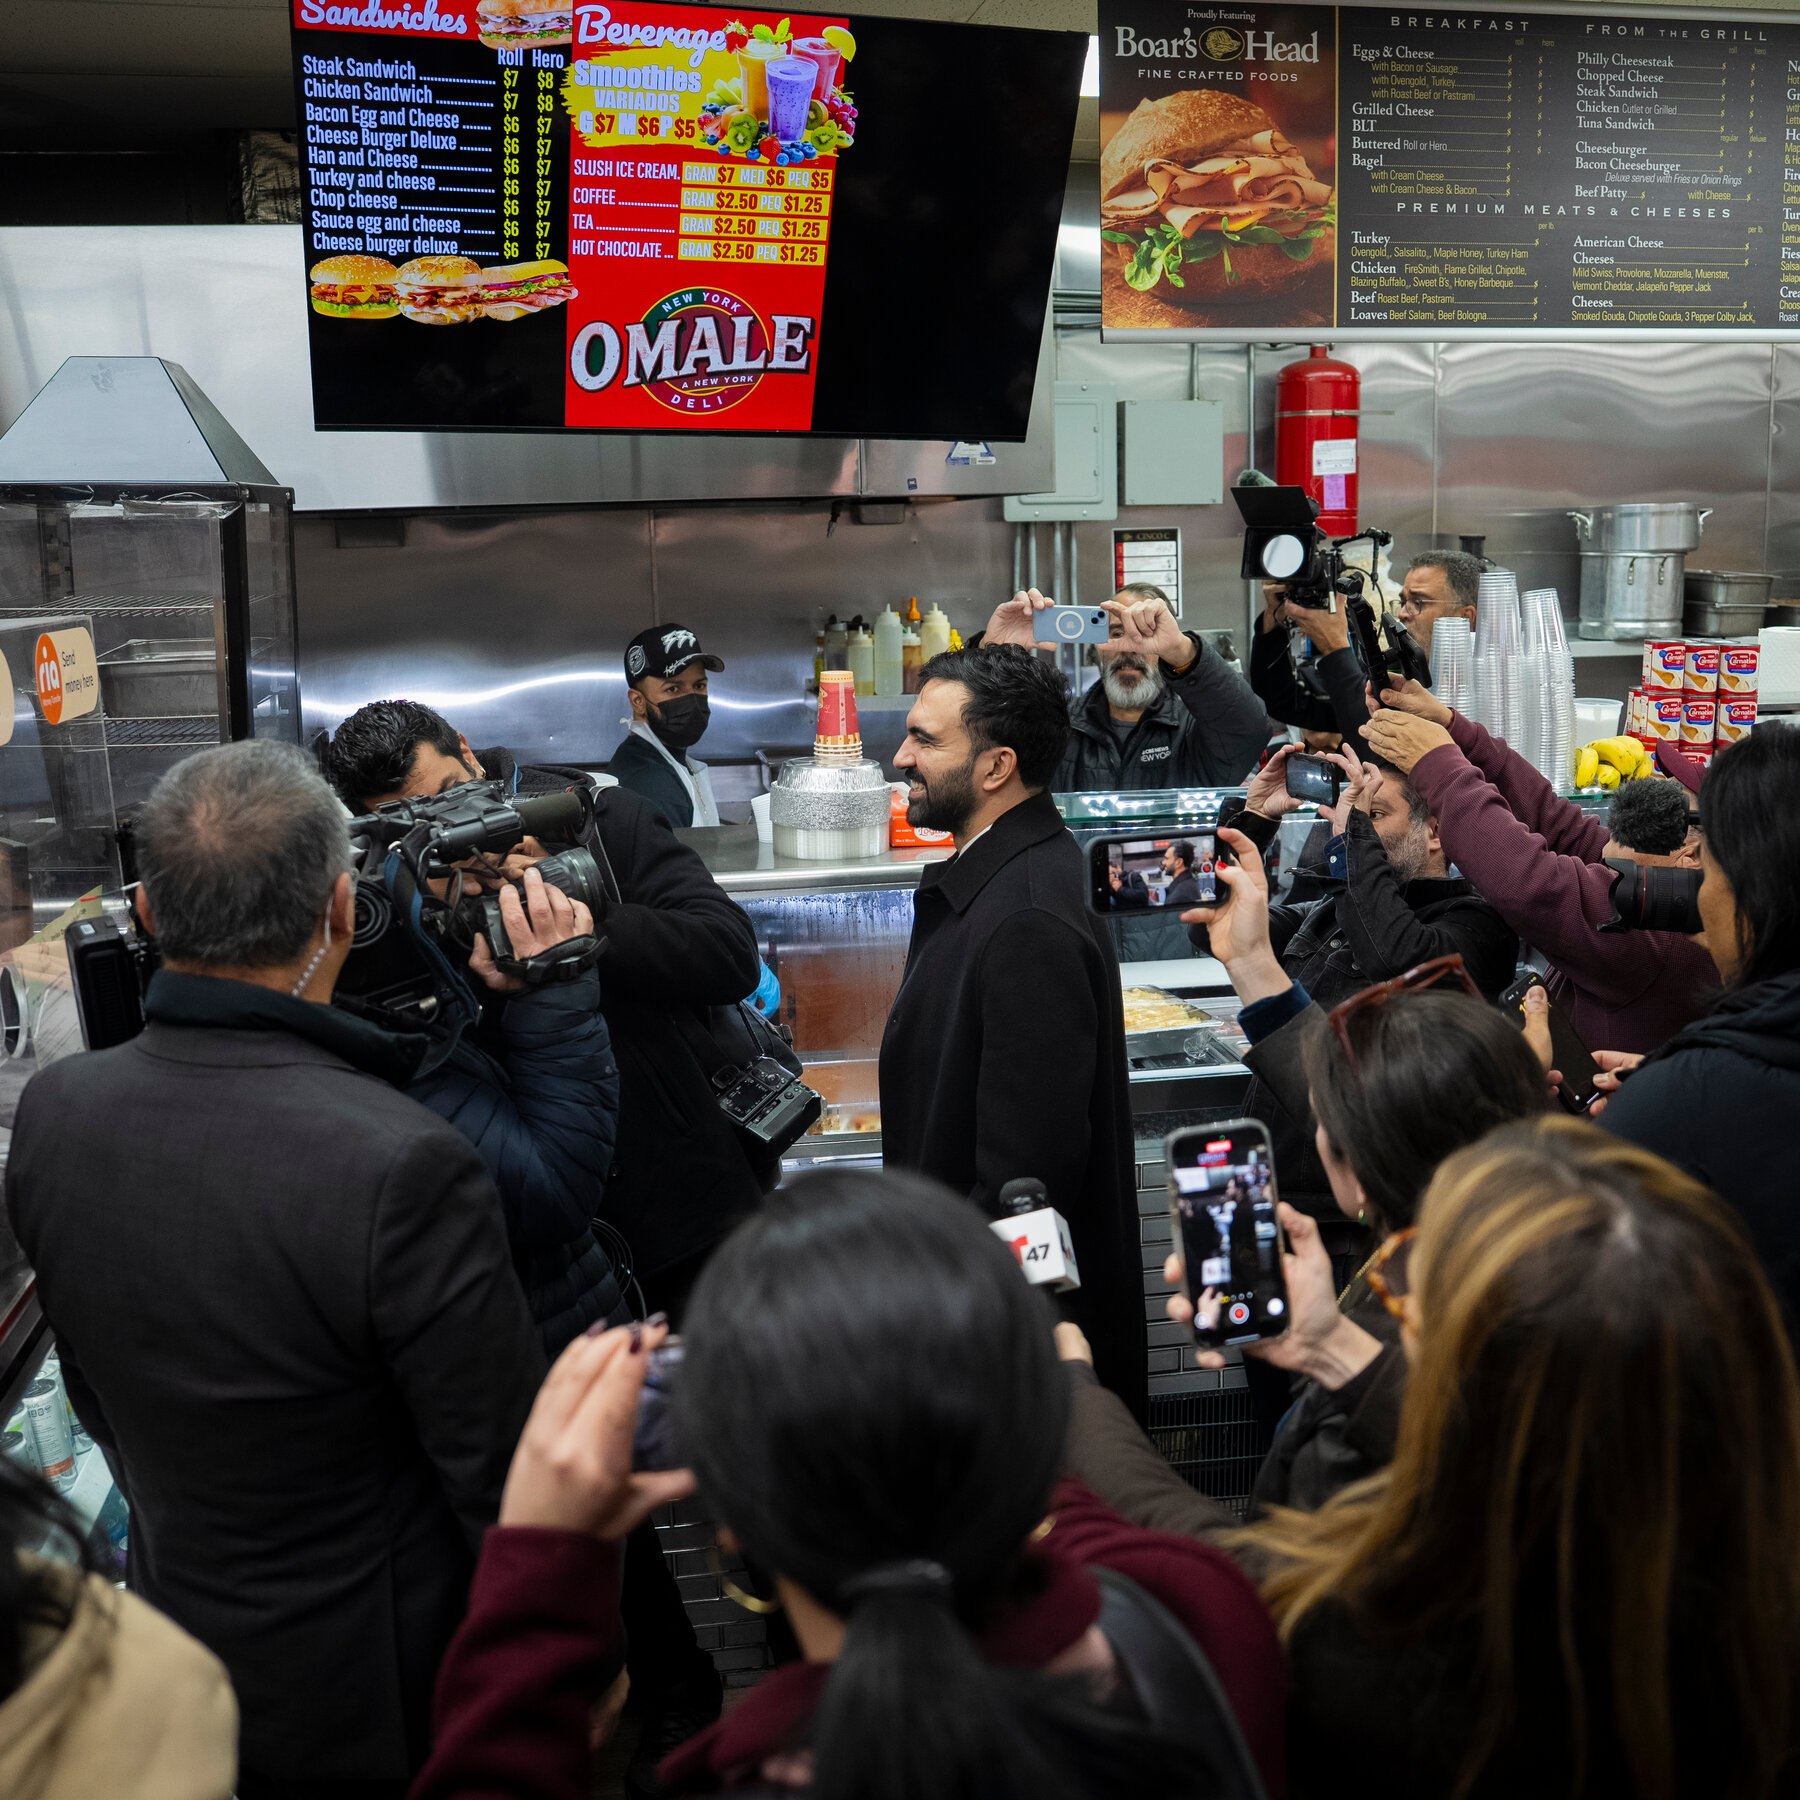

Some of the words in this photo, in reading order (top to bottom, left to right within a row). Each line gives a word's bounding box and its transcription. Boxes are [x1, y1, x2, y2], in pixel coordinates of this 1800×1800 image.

[301, 0, 467, 34] Sandwiches
[1187, 8, 1217, 21] Proudly
[1219, 10, 1256, 23] Featuring
[1391, 17, 1529, 31] BREAKFAST
[575, 5, 727, 68] Beverage
[1586, 25, 1644, 36] FROM
[1659, 30, 1688, 38] THE
[1700, 30, 1767, 41] GRILL
[1115, 26, 1197, 58] Boar's
[1245, 31, 1319, 63] Head
[1352, 44, 1380, 61] Eggs
[1383, 46, 1392, 57] &
[1396, 46, 1434, 59] Cheese
[498, 47, 523, 66] Roll
[532, 49, 564, 68] Hero
[1577, 52, 1609, 68] Philly
[1612, 53, 1674, 68] Cheesesteak
[303, 55, 344, 75] Steak
[347, 58, 416, 80] Sandwich
[504, 68, 518, 88] $7
[537, 70, 553, 90] $8
[574, 60, 702, 92] Smoothies
[1138, 70, 1171, 78] FINE
[1178, 71, 1244, 80] CRAFTED
[1250, 72, 1298, 81] FOODS
[1577, 68, 1625, 84] Chopped
[1628, 70, 1664, 83] Cheese
[304, 79, 360, 99] Chicken
[364, 84, 432, 103] Sandwich
[503, 91, 518, 111] $7
[537, 93, 553, 112] $8
[1577, 84, 1606, 98] Steak
[1609, 85, 1658, 99] Sandwich
[594, 89, 680, 112] VARIADOS
[1352, 102, 1393, 115] Grilled
[1396, 104, 1434, 116] Cheese
[1576, 101, 1619, 113] Chicken
[1622, 104, 1644, 114] Cutlet
[306, 103, 349, 122] Bacon
[352, 105, 377, 128] Egg
[380, 109, 406, 126] and
[409, 109, 459, 128] Cheese
[503, 114, 519, 134] $6
[537, 116, 551, 135] $7
[579, 111, 593, 134] G
[595, 112, 614, 135] $7
[618, 113, 636, 137] M
[638, 115, 659, 137] $6
[660, 115, 673, 137] P
[675, 118, 695, 139] $5
[1352, 120, 1377, 132] BLT
[1576, 116, 1602, 128] Tuna
[1605, 117, 1655, 130] Sandwich
[307, 125, 358, 144] Cheese
[362, 128, 407, 150] Burger
[411, 131, 456, 150] Deluxe
[503, 136, 519, 155] $6
[537, 138, 551, 157] $7
[1352, 137, 1400, 150] Buttered
[1403, 140, 1417, 149] Roll
[1420, 142, 1427, 150] or
[1429, 141, 1447, 150] Hero
[1576, 141, 1647, 158] Cheeseburger
[308, 146, 336, 165] Han
[339, 150, 364, 166] and
[368, 149, 418, 169] Cheese
[503, 157, 519, 176] $6
[537, 159, 551, 177] $7
[1352, 153, 1383, 170] Bagel
[1575, 157, 1607, 170] Bacon
[1610, 158, 1680, 174] Cheeseburger
[574, 159, 613, 177] SLUSH
[616, 162, 635, 177] ICE
[684, 166, 716, 182] GRAN
[718, 166, 735, 184] $7
[740, 168, 765, 184] MED
[766, 168, 785, 186] $6
[788, 171, 810, 188] PEQ
[811, 170, 829, 189] $5
[309, 168, 354, 190] Turkey
[358, 171, 383, 188] and
[387, 173, 435, 191] cheese
[503, 178, 519, 197] $6
[537, 180, 551, 199] $7
[573, 187, 616, 205] COFFEE
[683, 191, 714, 207] GRAN
[716, 192, 758, 211] $2.50
[760, 195, 781, 212] PEQ
[784, 195, 822, 213] $1.25
[1575, 185, 1600, 197] Beef
[1601, 186, 1627, 200] Patty
[311, 189, 345, 209] Chop
[349, 191, 397, 209] cheese
[503, 199, 519, 217] $6
[536, 200, 550, 219] $7
[1397, 203, 1505, 214] PREMIUM
[1524, 205, 1596, 216] MEATS
[1610, 208, 1618, 216] &
[1631, 206, 1730, 218] CHEESES
[312, 211, 353, 229] Sauce
[357, 215, 382, 234] egg
[385, 214, 409, 231] and
[413, 215, 461, 233] cheese
[503, 219, 519, 239] $6
[536, 221, 550, 239] $7
[572, 214, 593, 230] TEA
[682, 217, 713, 232] GRAN
[714, 218, 756, 236] $2.50
[759, 220, 780, 237] PEQ
[782, 220, 820, 239] $1.25
[313, 233, 362, 251] Cheese
[366, 235, 410, 255] burger
[414, 236, 458, 255] deluxe
[503, 240, 519, 259] $6
[536, 242, 550, 260] $7
[1351, 231, 1390, 247] Turkey
[1574, 236, 1625, 248] American
[1628, 236, 1664, 248] Cheese
[572, 240, 594, 255] HOT
[597, 240, 661, 258] CHOCOLATE
[680, 241, 712, 257] GRAN
[713, 243, 754, 261] $2.50
[757, 245, 778, 262] PEQ
[780, 244, 818, 263] $1.25
[1573, 253, 1614, 265] Cheeses
[1351, 261, 1396, 274] Chicken
[662, 293, 693, 313] NEW
[702, 292, 741, 313] YORK
[1351, 291, 1377, 303] Beef
[1572, 296, 1613, 308] Cheeses
[1351, 308, 1387, 320] Loaves
[570, 315, 813, 393] OMALE
[695, 378, 717, 386] NEW
[721, 376, 754, 384] YORK
[671, 394, 723, 408] DELI
[62, 649, 75, 667] Send
[40, 646, 60, 693] ria
[66, 679, 82, 694] money
[83, 674, 94, 688] here
[1026, 1243, 1050, 1261] 47
